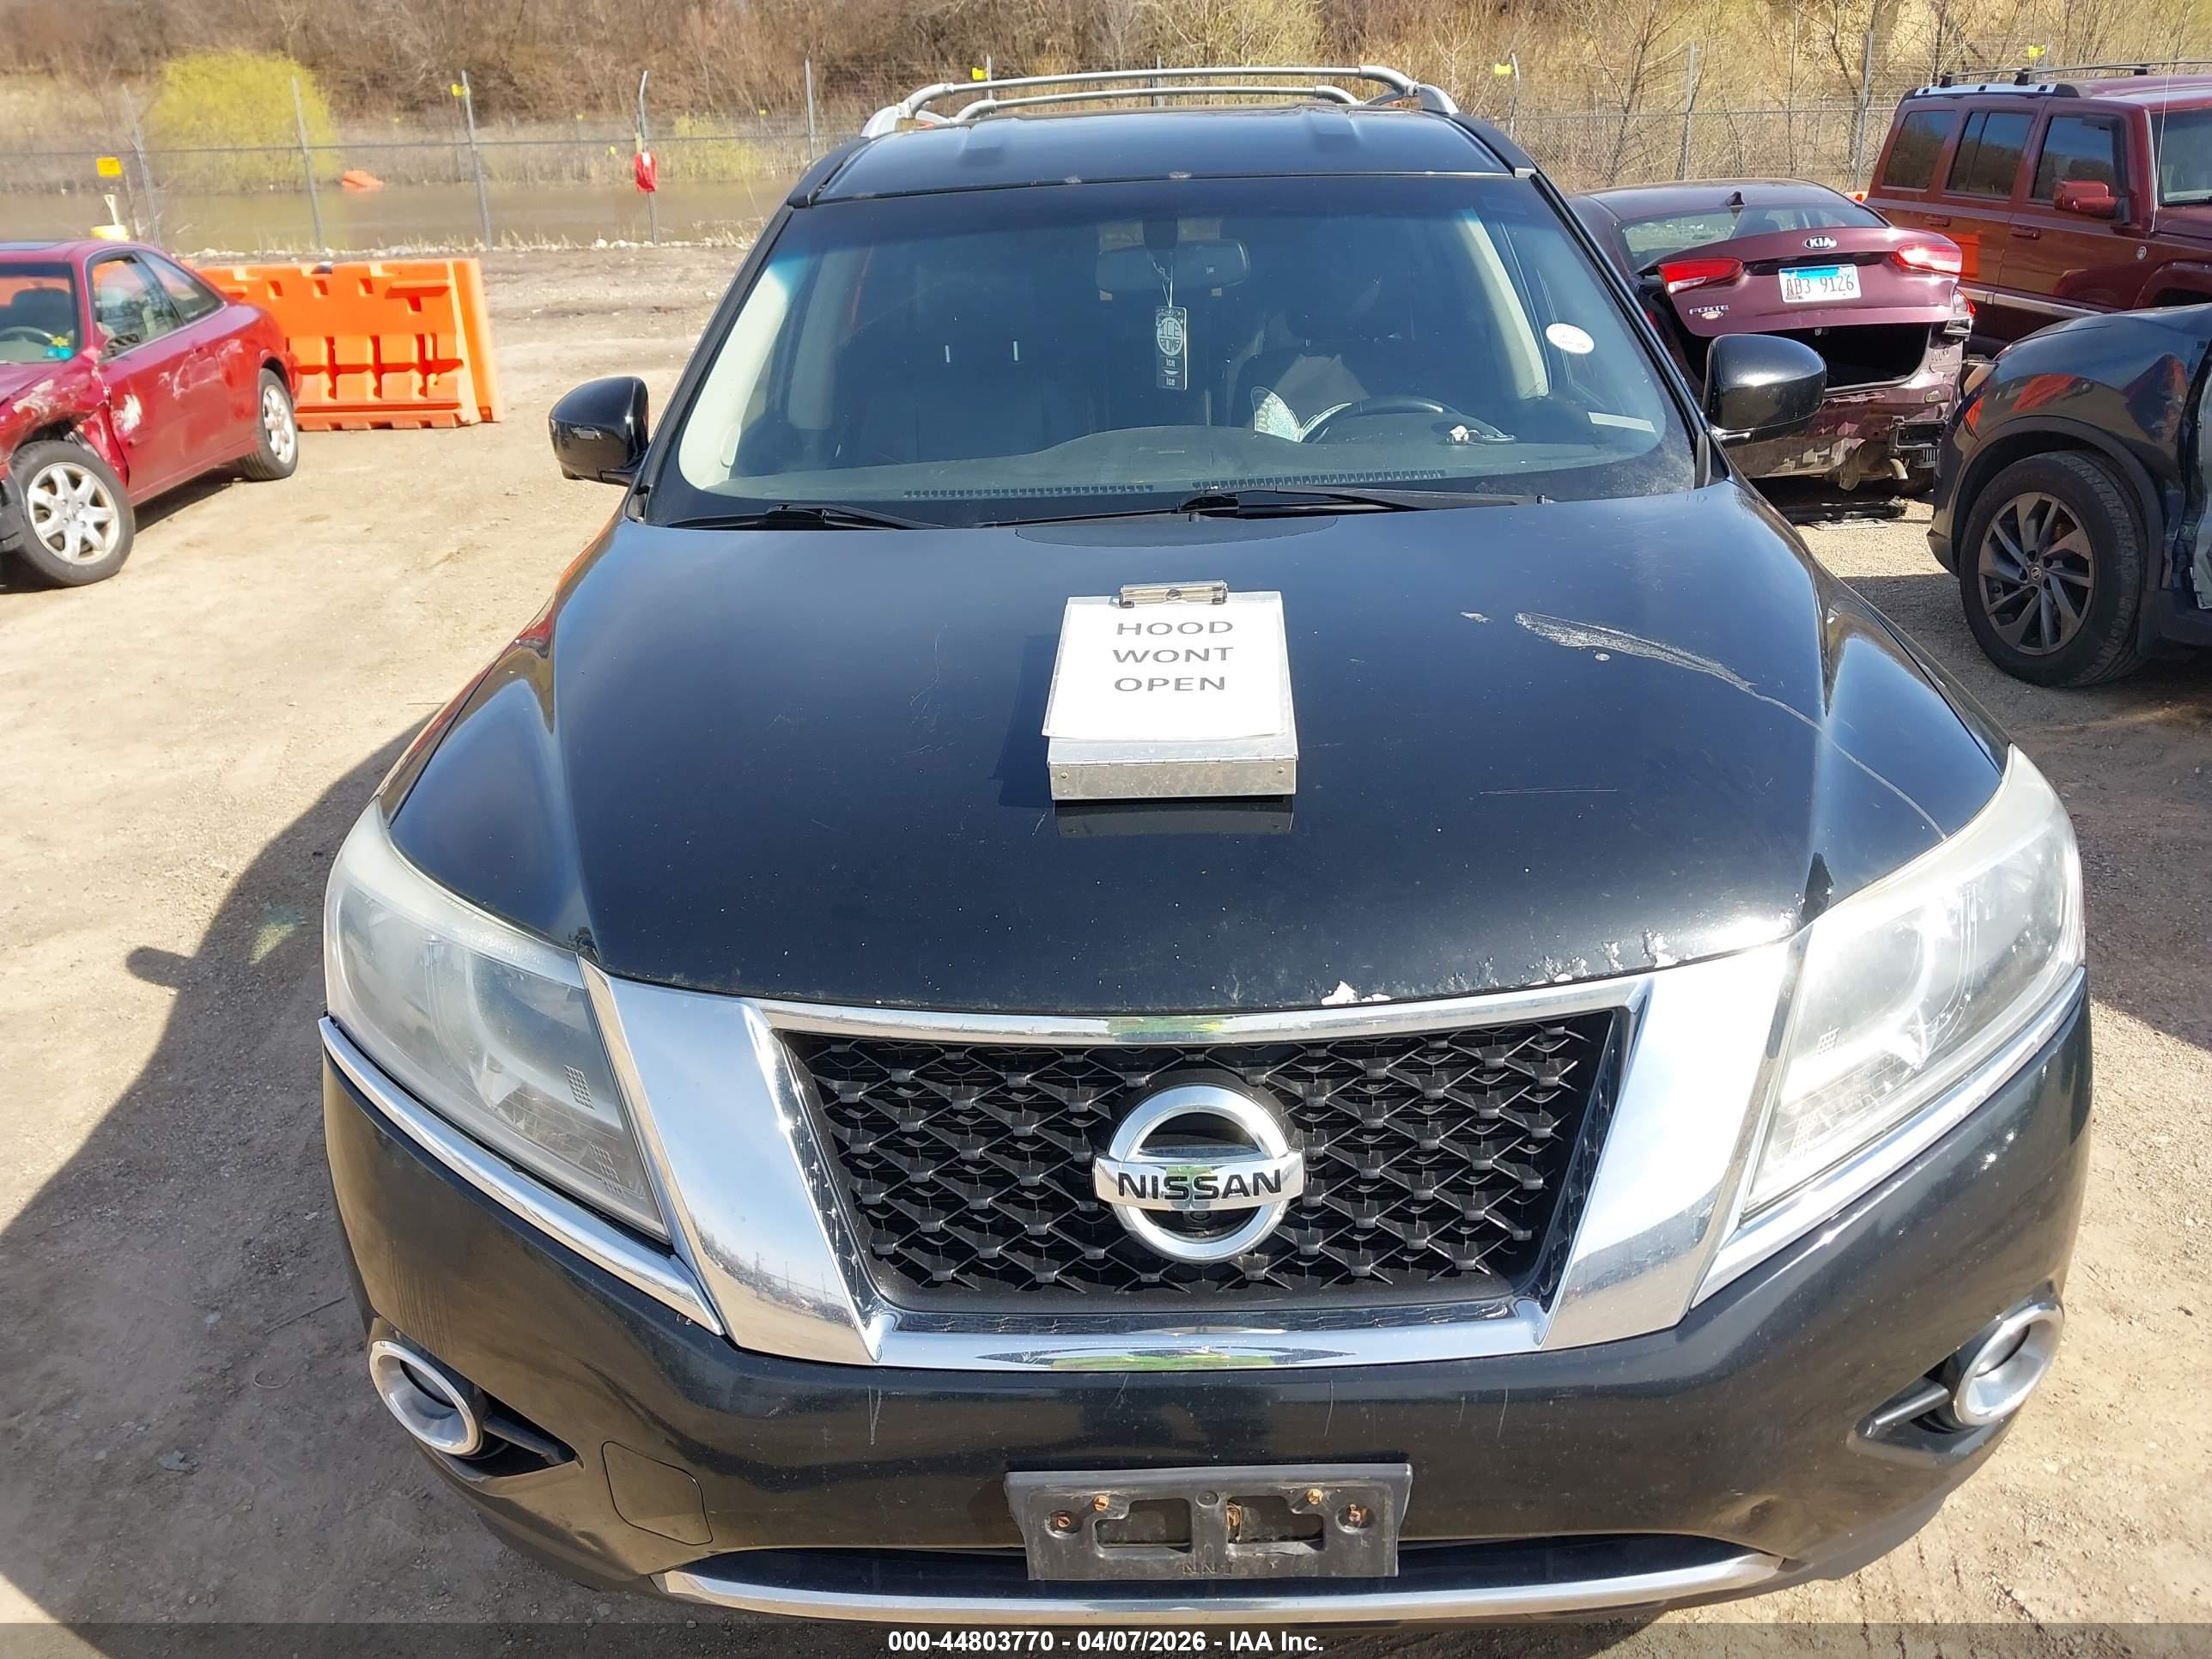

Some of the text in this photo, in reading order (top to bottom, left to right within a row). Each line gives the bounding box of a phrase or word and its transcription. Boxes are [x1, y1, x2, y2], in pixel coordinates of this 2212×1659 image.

[1809, 237, 1836, 248] KIA
[1786, 274, 1855, 295] AB3 9126
[1160, 320, 1182, 337] ICE
[1166, 357, 1176, 367] Ice
[1166, 377, 1176, 386] Ice
[1116, 621, 1234, 635] HOOD
[1112, 647, 1235, 663] WONT
[1114, 677, 1225, 692] OPEN
[1117, 1169, 1282, 1200] NISSAN
